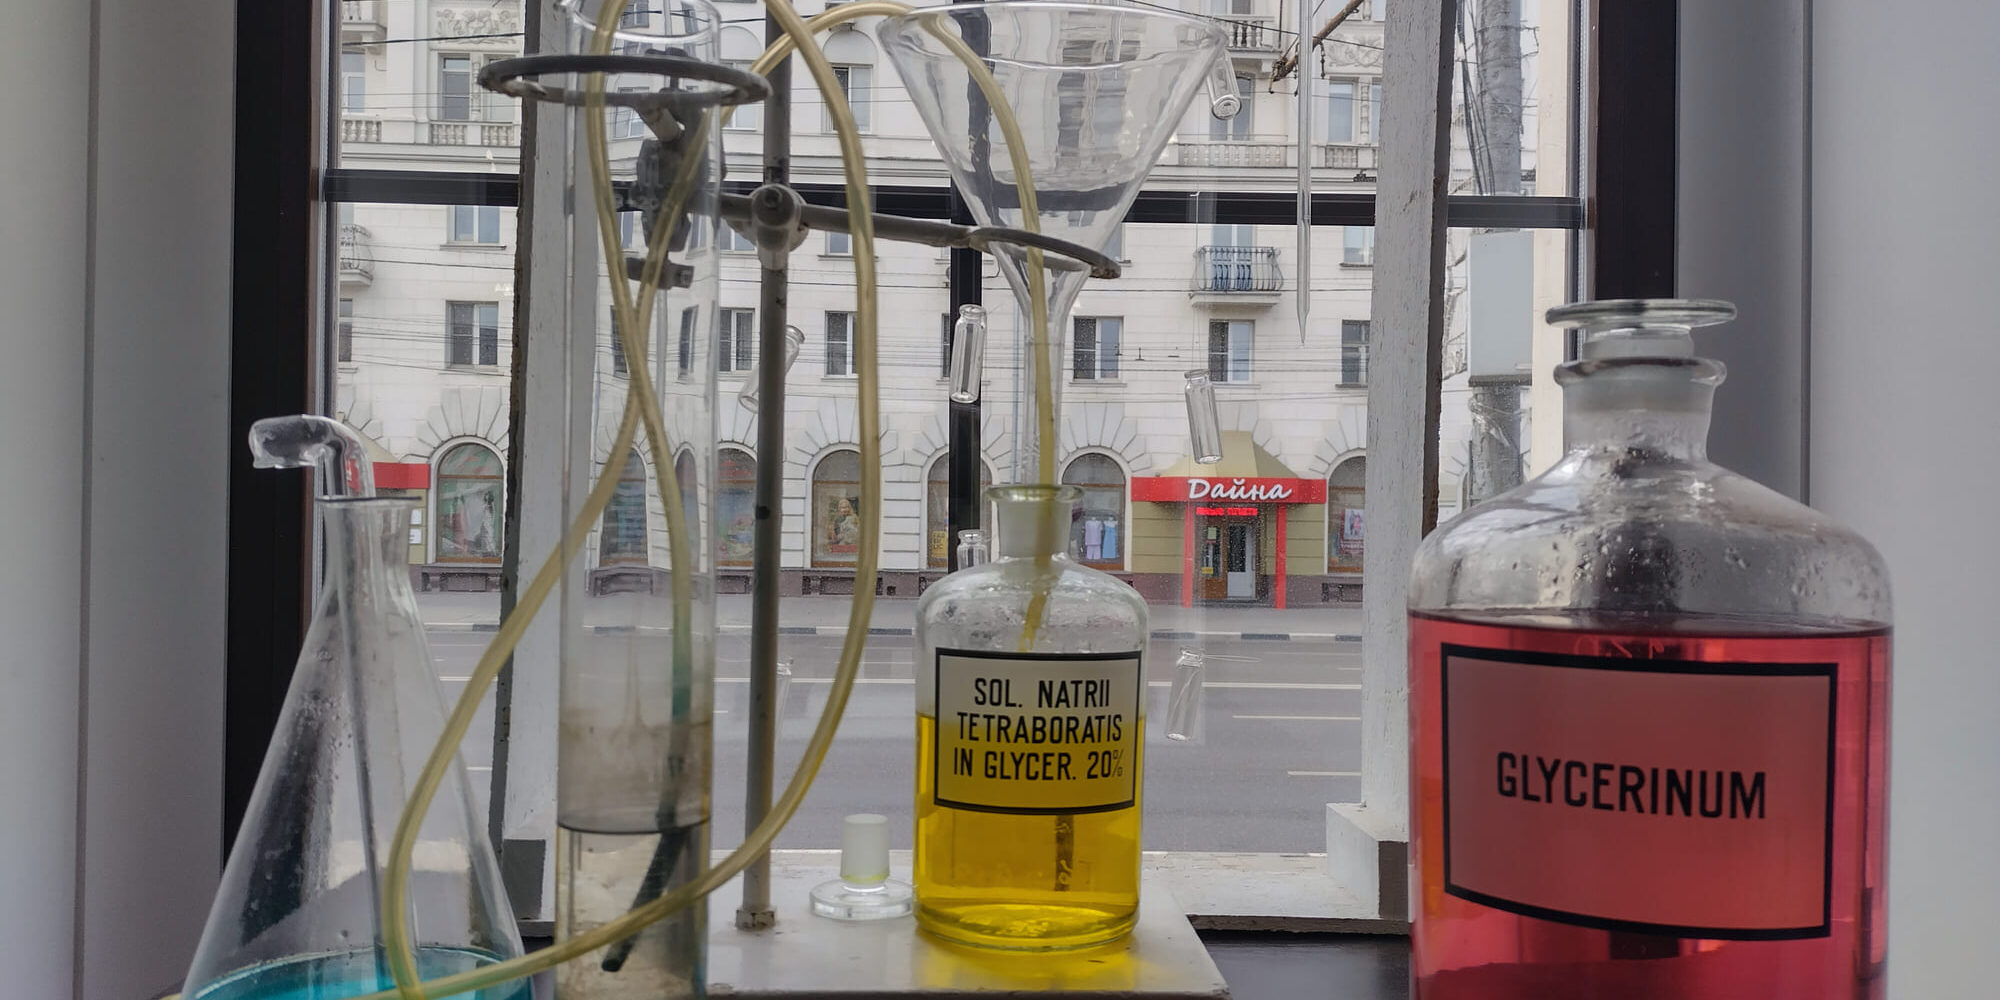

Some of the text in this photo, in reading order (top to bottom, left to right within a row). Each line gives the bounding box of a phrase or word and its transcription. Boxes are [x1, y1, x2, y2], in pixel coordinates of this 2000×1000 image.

[1188, 478, 1293, 501] Дайна
[974, 677, 1110, 708] SOL. NATRII
[957, 712, 1122, 744] TETRABORATIS
[953, 747, 1124, 780] IN GLYCER. 20%
[1496, 751, 1767, 820] GLYCERINUM
